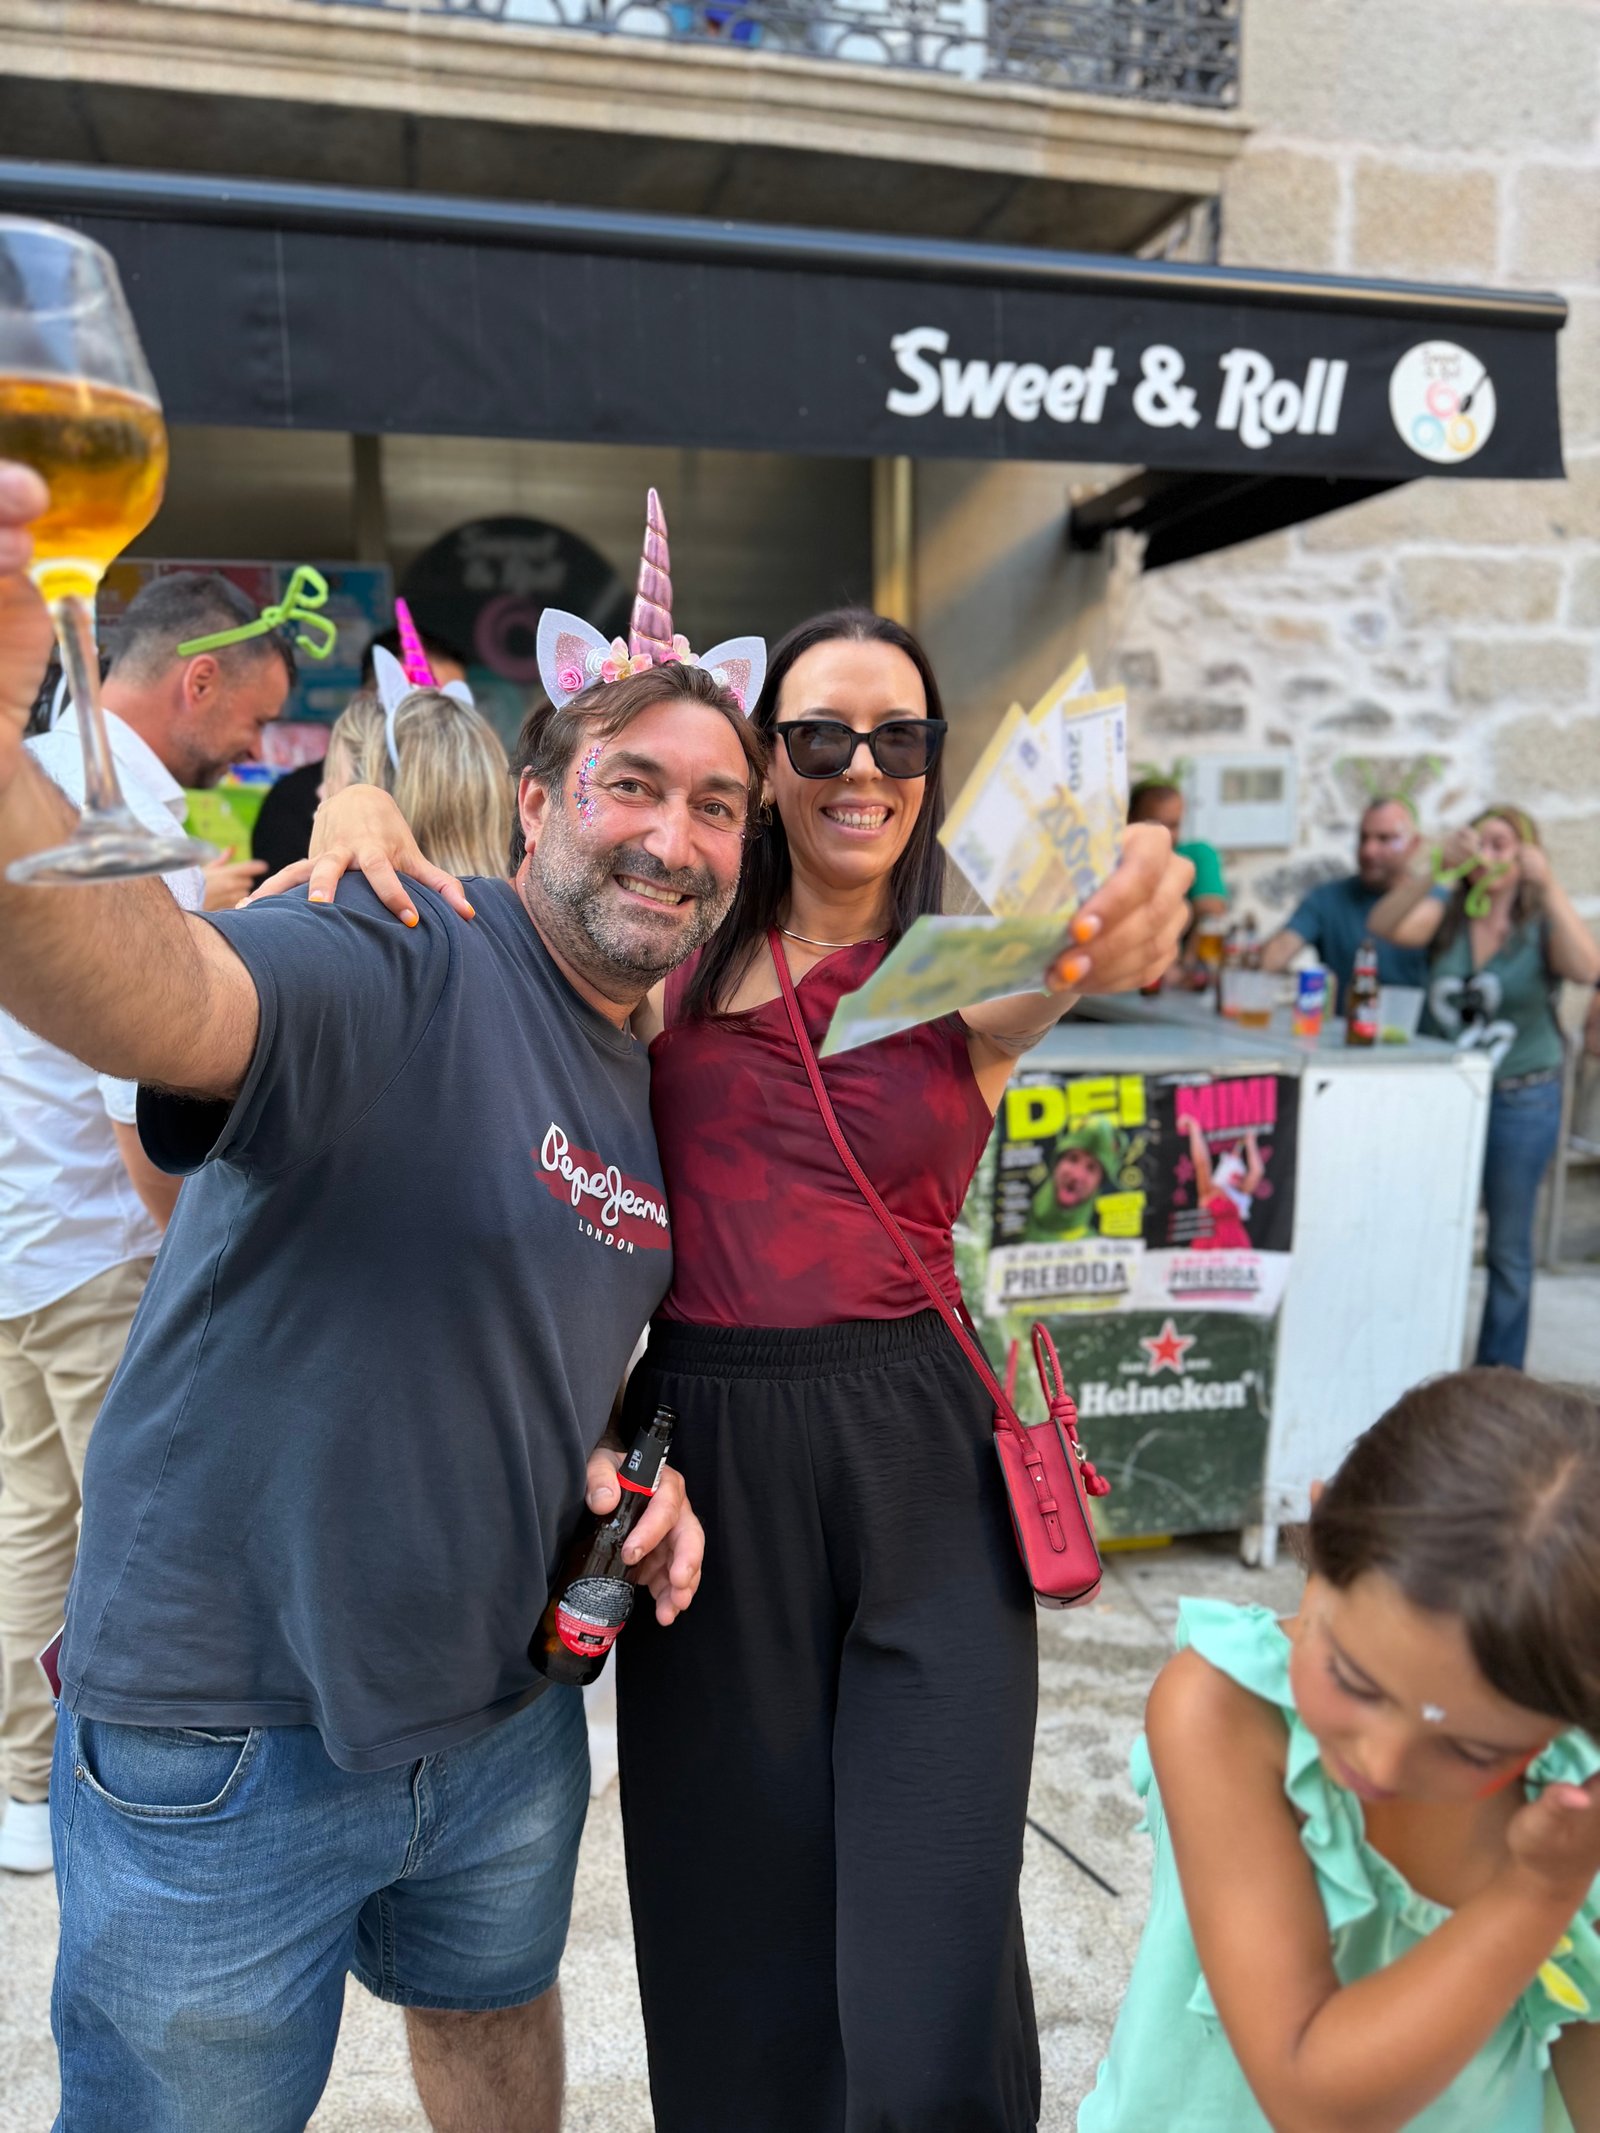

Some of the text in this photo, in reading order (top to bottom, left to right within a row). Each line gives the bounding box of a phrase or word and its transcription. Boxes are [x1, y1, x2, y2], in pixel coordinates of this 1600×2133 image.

[886, 327, 1348, 449] Sweet & Roll
[578, 1219, 634, 1254] LONDON
[1003, 1261, 1128, 1291] PREBODA
[1079, 1377, 1247, 1417] Heineken
